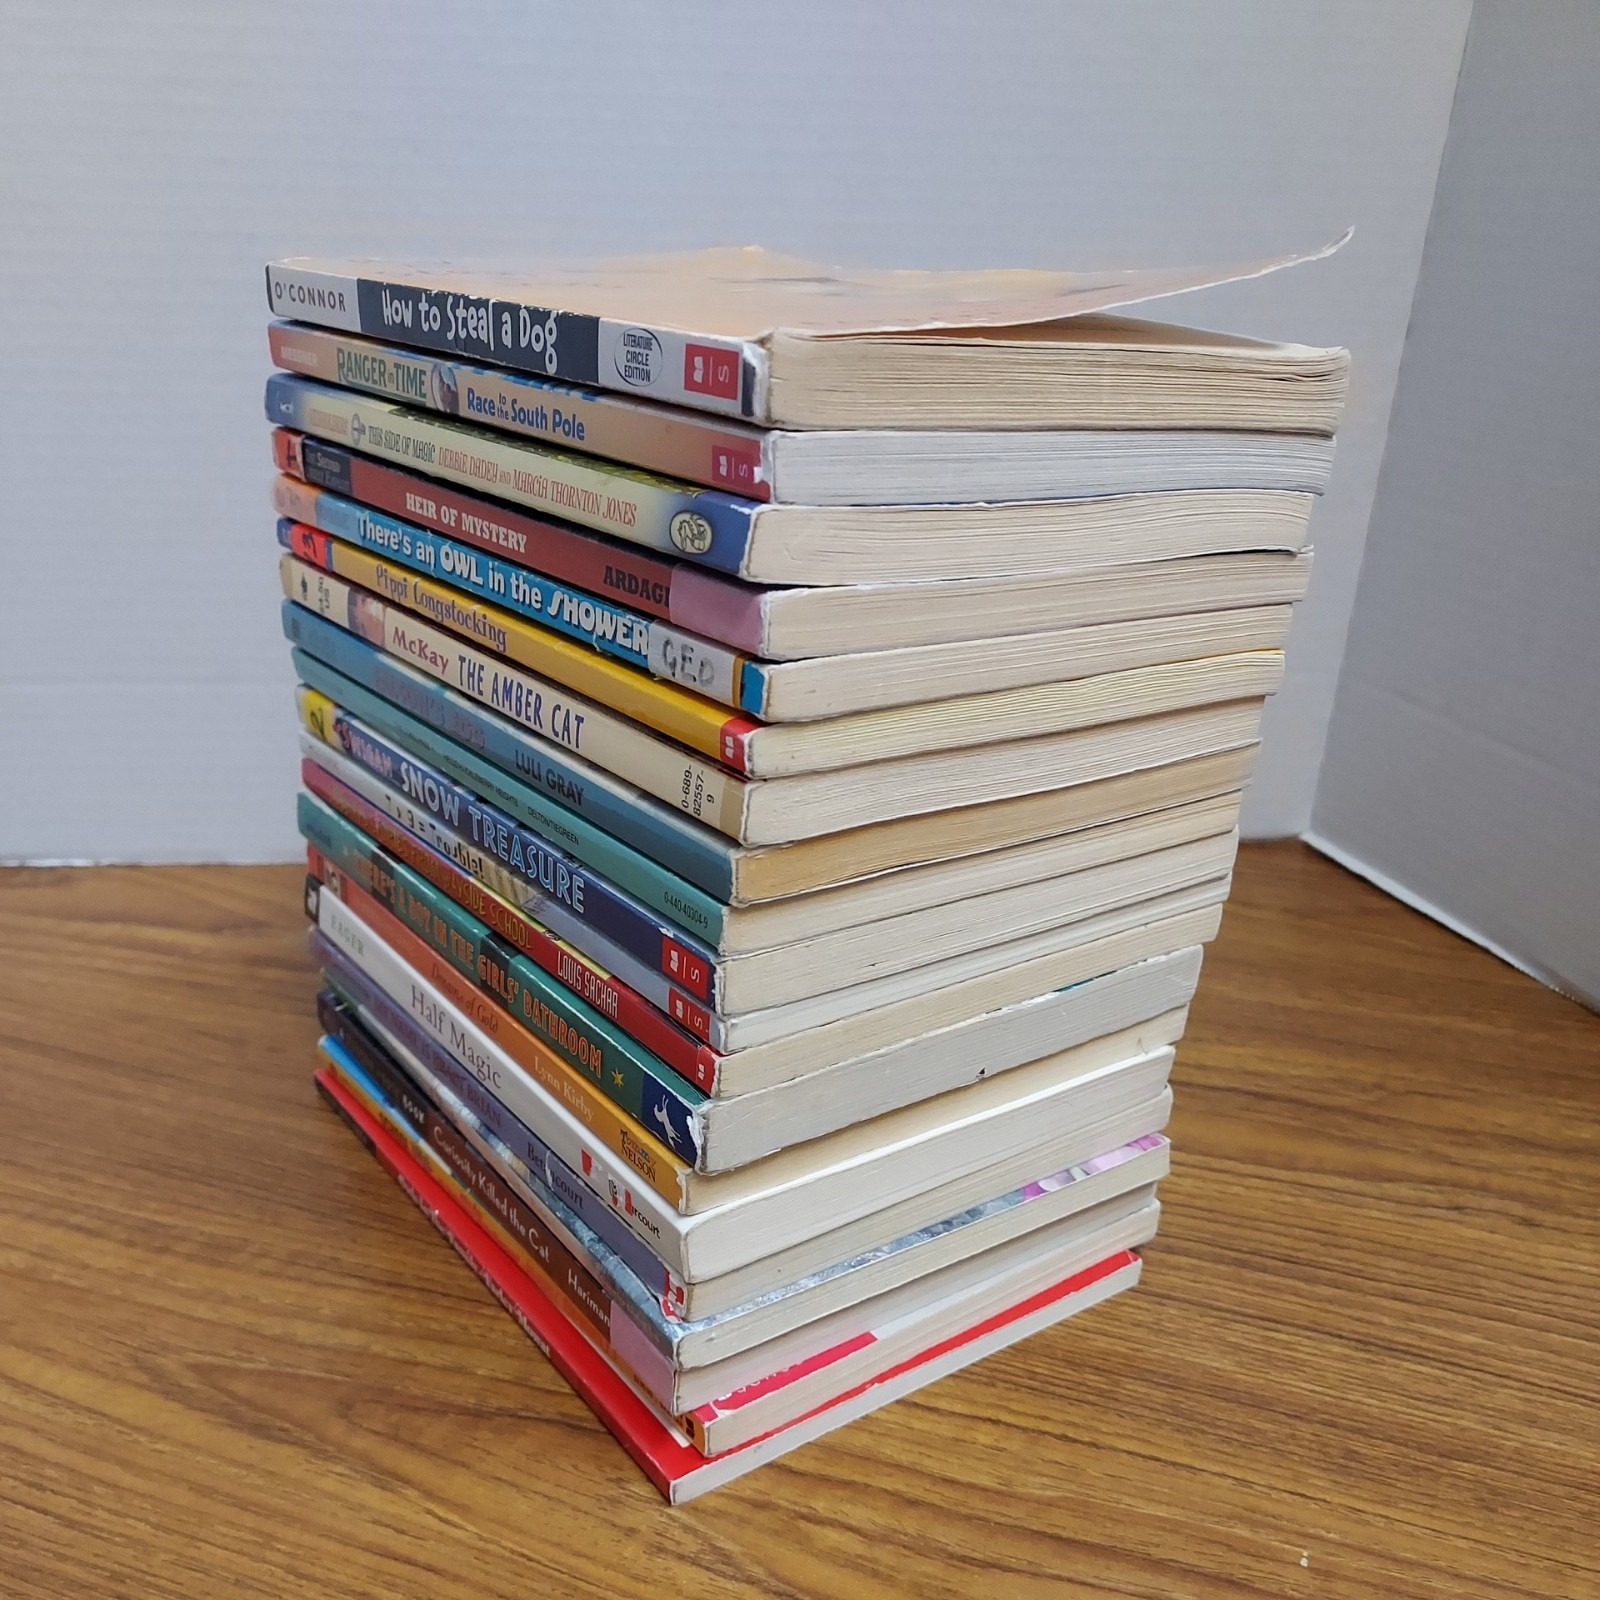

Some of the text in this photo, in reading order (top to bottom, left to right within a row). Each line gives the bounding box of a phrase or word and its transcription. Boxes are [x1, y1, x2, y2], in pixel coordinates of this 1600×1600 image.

[274, 281, 346, 312] O'CONNOR
[382, 288, 558, 374] How to Steal a Dog
[623, 332, 653, 352] LITERATURE
[626, 350, 650, 367] CIRCLE
[336, 347, 387, 388] RANGER
[394, 362, 427, 399] TIME
[624, 364, 650, 382] EDITION
[467, 386, 585, 442] Race to the South Pole
[401, 436, 412, 456] OF
[551, 480, 602, 516] THORNTON
[602, 496, 638, 527] JONES
[406, 492, 528, 554] HEIR OF MYSTERY
[357, 511, 412, 556] There's
[416, 540, 436, 566] an
[440, 544, 484, 586] OWL
[488, 561, 505, 594] in
[510, 572, 542, 610] the
[548, 590, 650, 656] SHOWER
[376, 563, 507, 654] Pippi Longstocking
[393, 626, 449, 675] McKay
[458, 654, 485, 697] THE
[491, 672, 543, 730] AMBER
[551, 703, 585, 750] CAT
[515, 749, 585, 806] LULI GRAY
[682, 764, 693, 809] 0-689-
[706, 794, 715, 804] 9
[400, 762, 460, 827] SNOW
[468, 805, 585, 914] TREASURE
[490, 904, 532, 950] SCHOOL
[664, 891, 708, 929] 0-440-40304-9
[451, 926, 474, 971] THE
[477, 954, 520, 1004] GIRLS'
[523, 988, 602, 1079] BATHROOM
[557, 951, 618, 1020] LOUIS SACHAR
[411, 984, 446, 1034] Half
[450, 1022, 502, 1090] Magic
[534, 1055, 560, 1090] Lynn
[563, 1081, 594, 1122] Kirby
[433, 1126, 476, 1185] Curiosity
[478, 1171, 508, 1216] Killed
[510, 1208, 526, 1237] the
[528, 1228, 550, 1264] Cat
